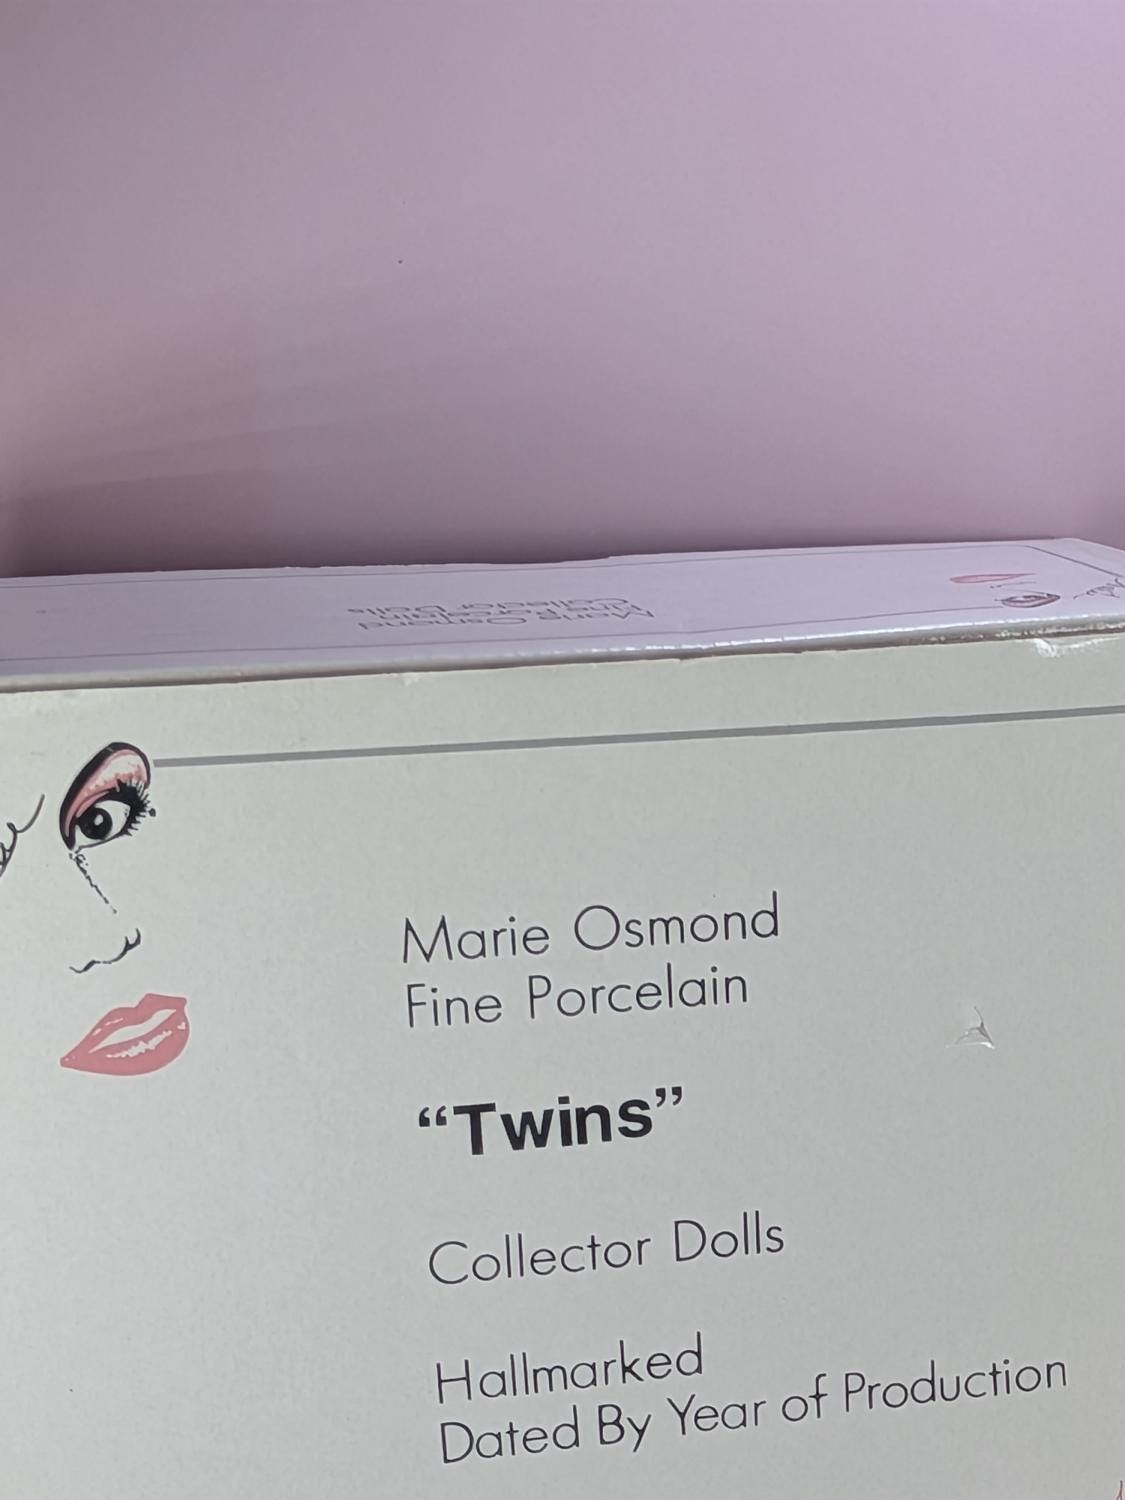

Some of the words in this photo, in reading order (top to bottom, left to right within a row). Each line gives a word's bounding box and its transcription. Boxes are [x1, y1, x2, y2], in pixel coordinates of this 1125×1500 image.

[403, 914, 550, 964] Marie
[574, 890, 780, 951] Osmond
[406, 983, 503, 1028] Fine
[528, 962, 747, 1019] Porcelain
[418, 1086, 683, 1156] "Twins"
[427, 1232, 652, 1285] Collector
[672, 1210, 786, 1263] Dolls
[435, 1330, 704, 1404] Hallmarked
[440, 1405, 580, 1464] Dated
[597, 1403, 653, 1452] By
[666, 1394, 766, 1436] Year
[781, 1373, 827, 1422] of
[844, 1358, 1068, 1413] Production
